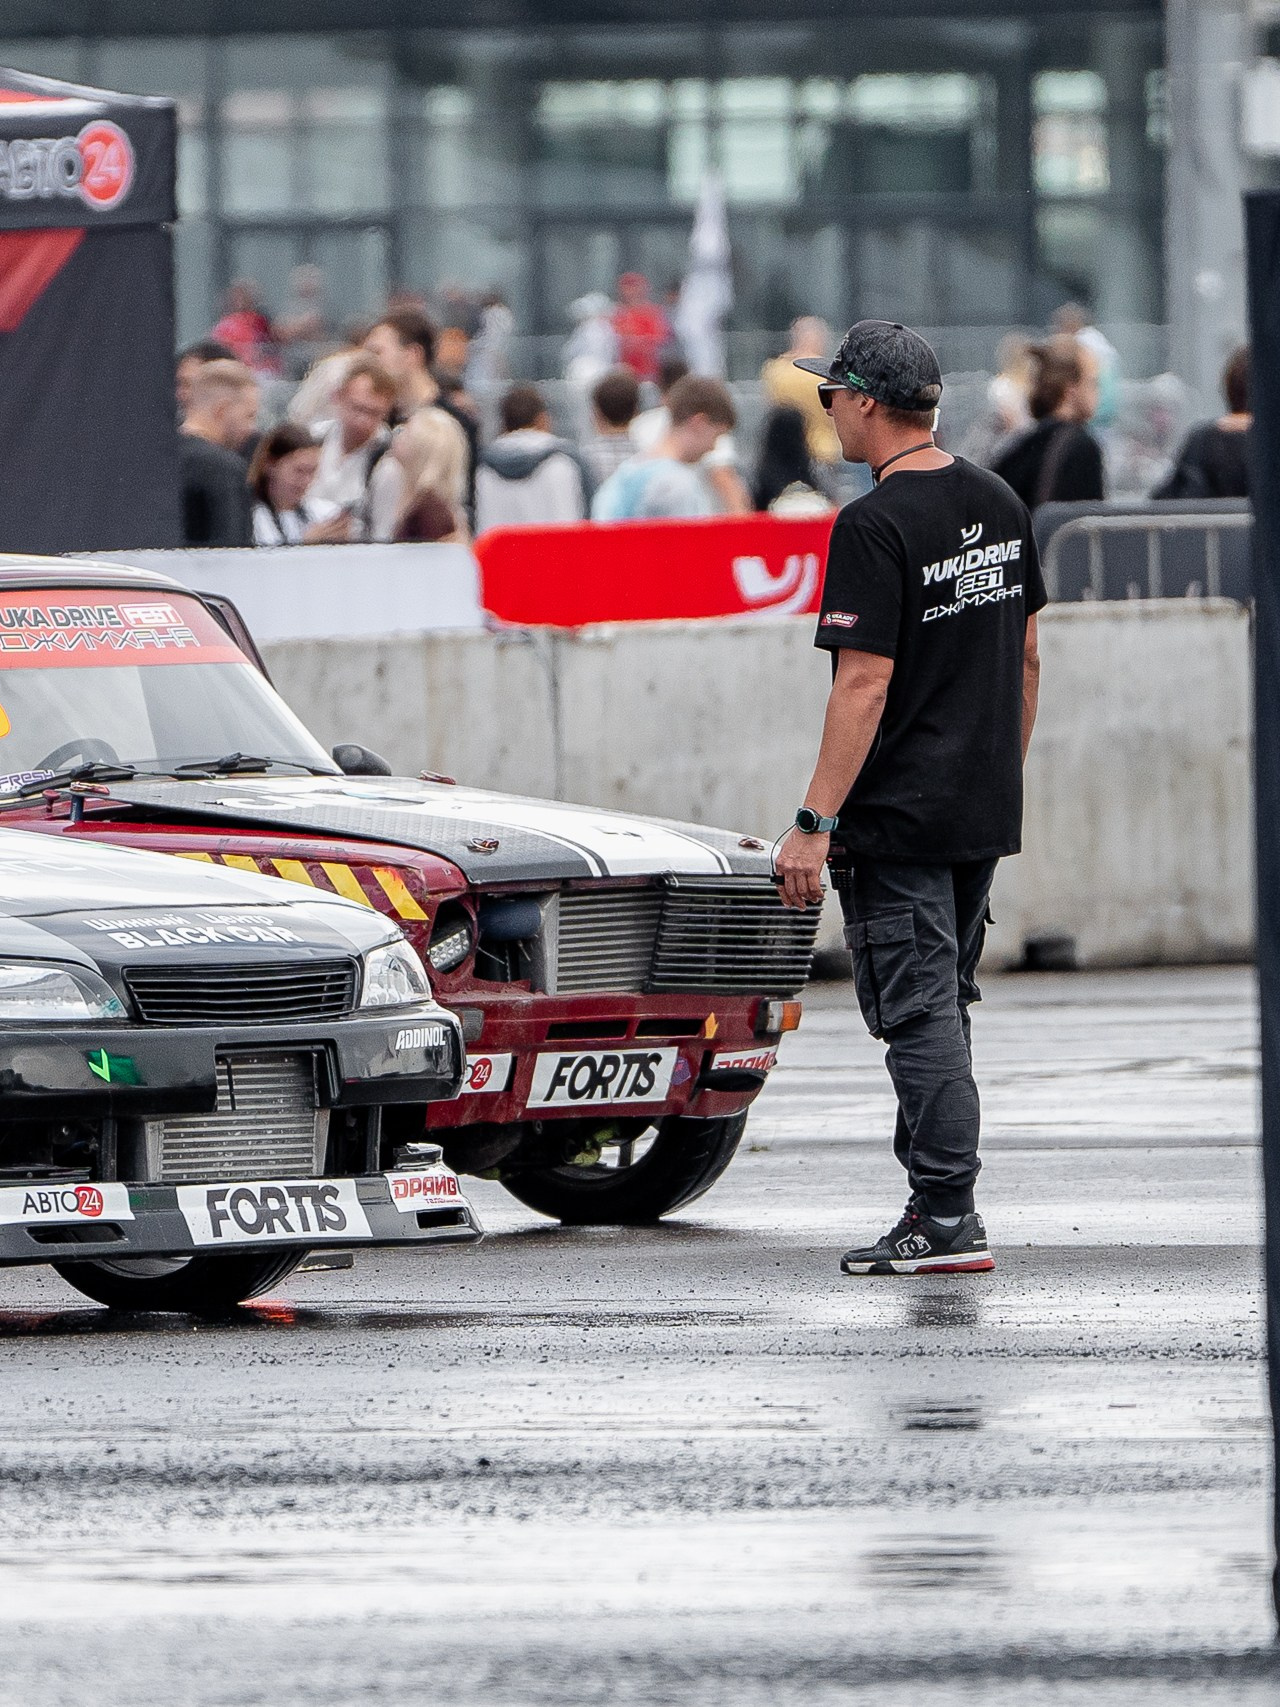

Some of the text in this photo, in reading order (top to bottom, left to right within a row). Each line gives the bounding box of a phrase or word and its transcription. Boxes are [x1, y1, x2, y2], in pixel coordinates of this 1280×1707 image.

[49, 604, 124, 629] DRIVE
[82, 913, 275, 931] Шинный Центр
[107, 925, 306, 950] BLACK CAR
[395, 1026, 447, 1050] ADDINOL
[542, 1052, 664, 1103] FORTIS
[392, 1174, 457, 1200] ДРАЙВ
[206, 1184, 348, 1239] FORTIS
